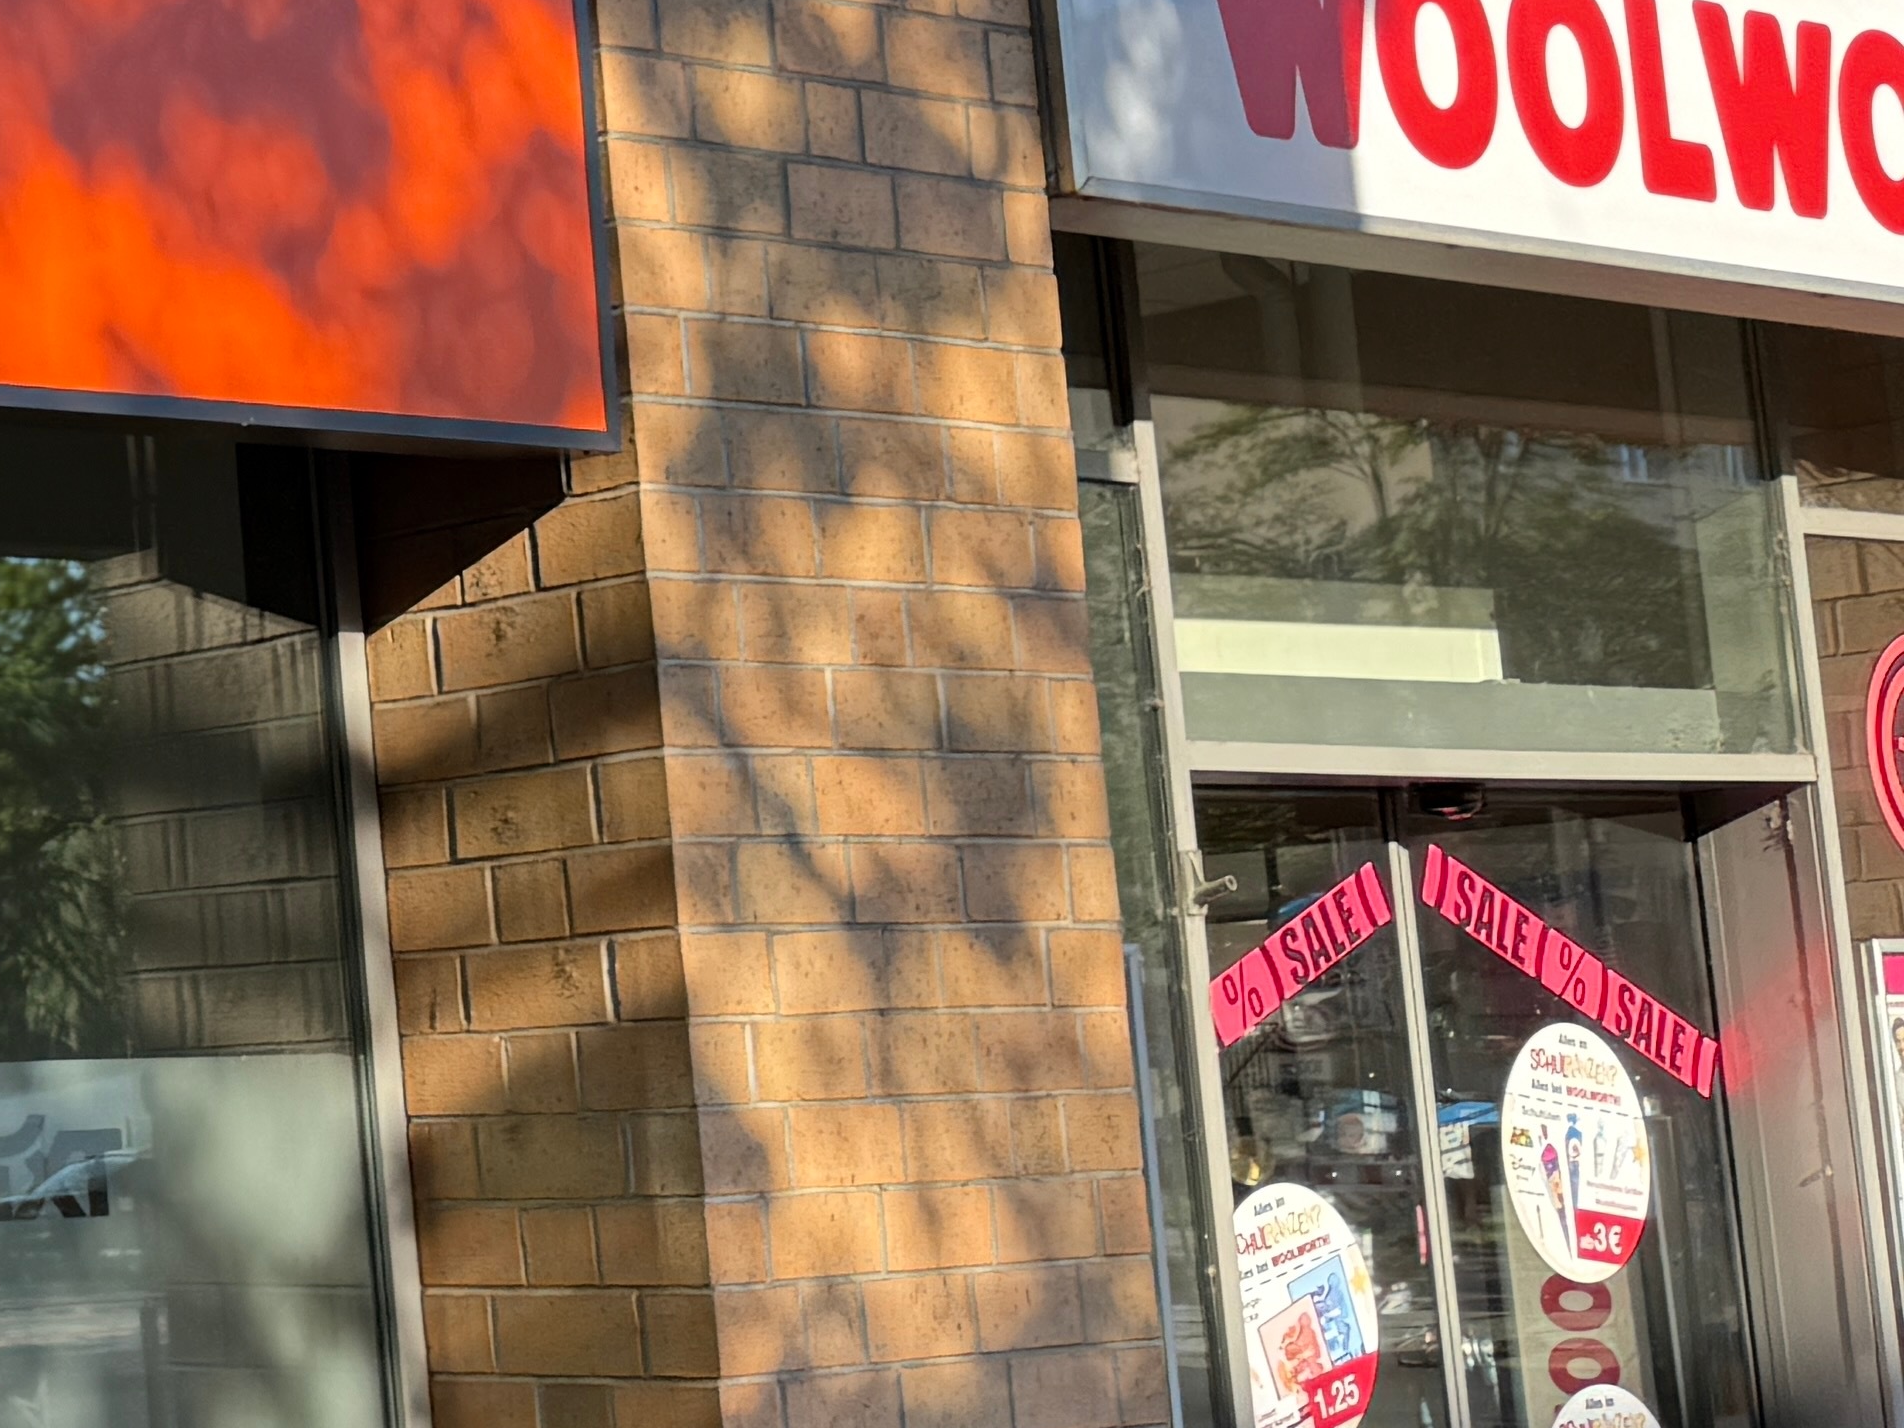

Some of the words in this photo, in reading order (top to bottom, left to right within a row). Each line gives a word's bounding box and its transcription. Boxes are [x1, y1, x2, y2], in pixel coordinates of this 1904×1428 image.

[1280, 887, 1362, 985] SALE
[1454, 870, 1530, 968] SALE
[1615, 982, 1688, 1076] SALE
[1313, 1374, 1360, 1419] 1.25
